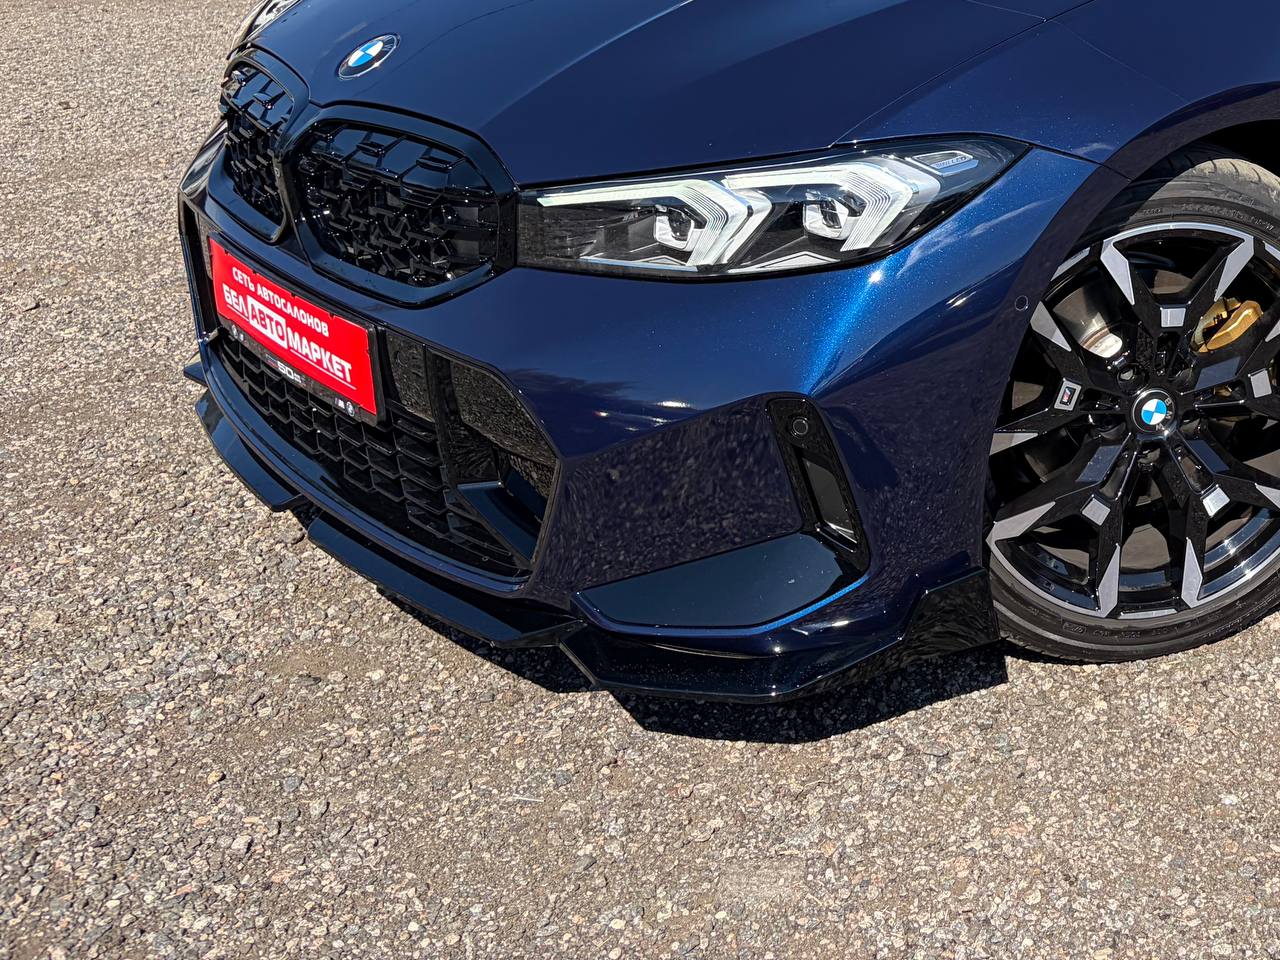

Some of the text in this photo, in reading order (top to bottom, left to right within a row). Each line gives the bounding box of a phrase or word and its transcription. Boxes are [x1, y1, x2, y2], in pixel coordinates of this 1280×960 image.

[222, 283, 352, 383] БЕЛ АВТО МАРКЕТ
[232, 267, 330, 337] СЕТЬ АВТОСАЛОНОВ
